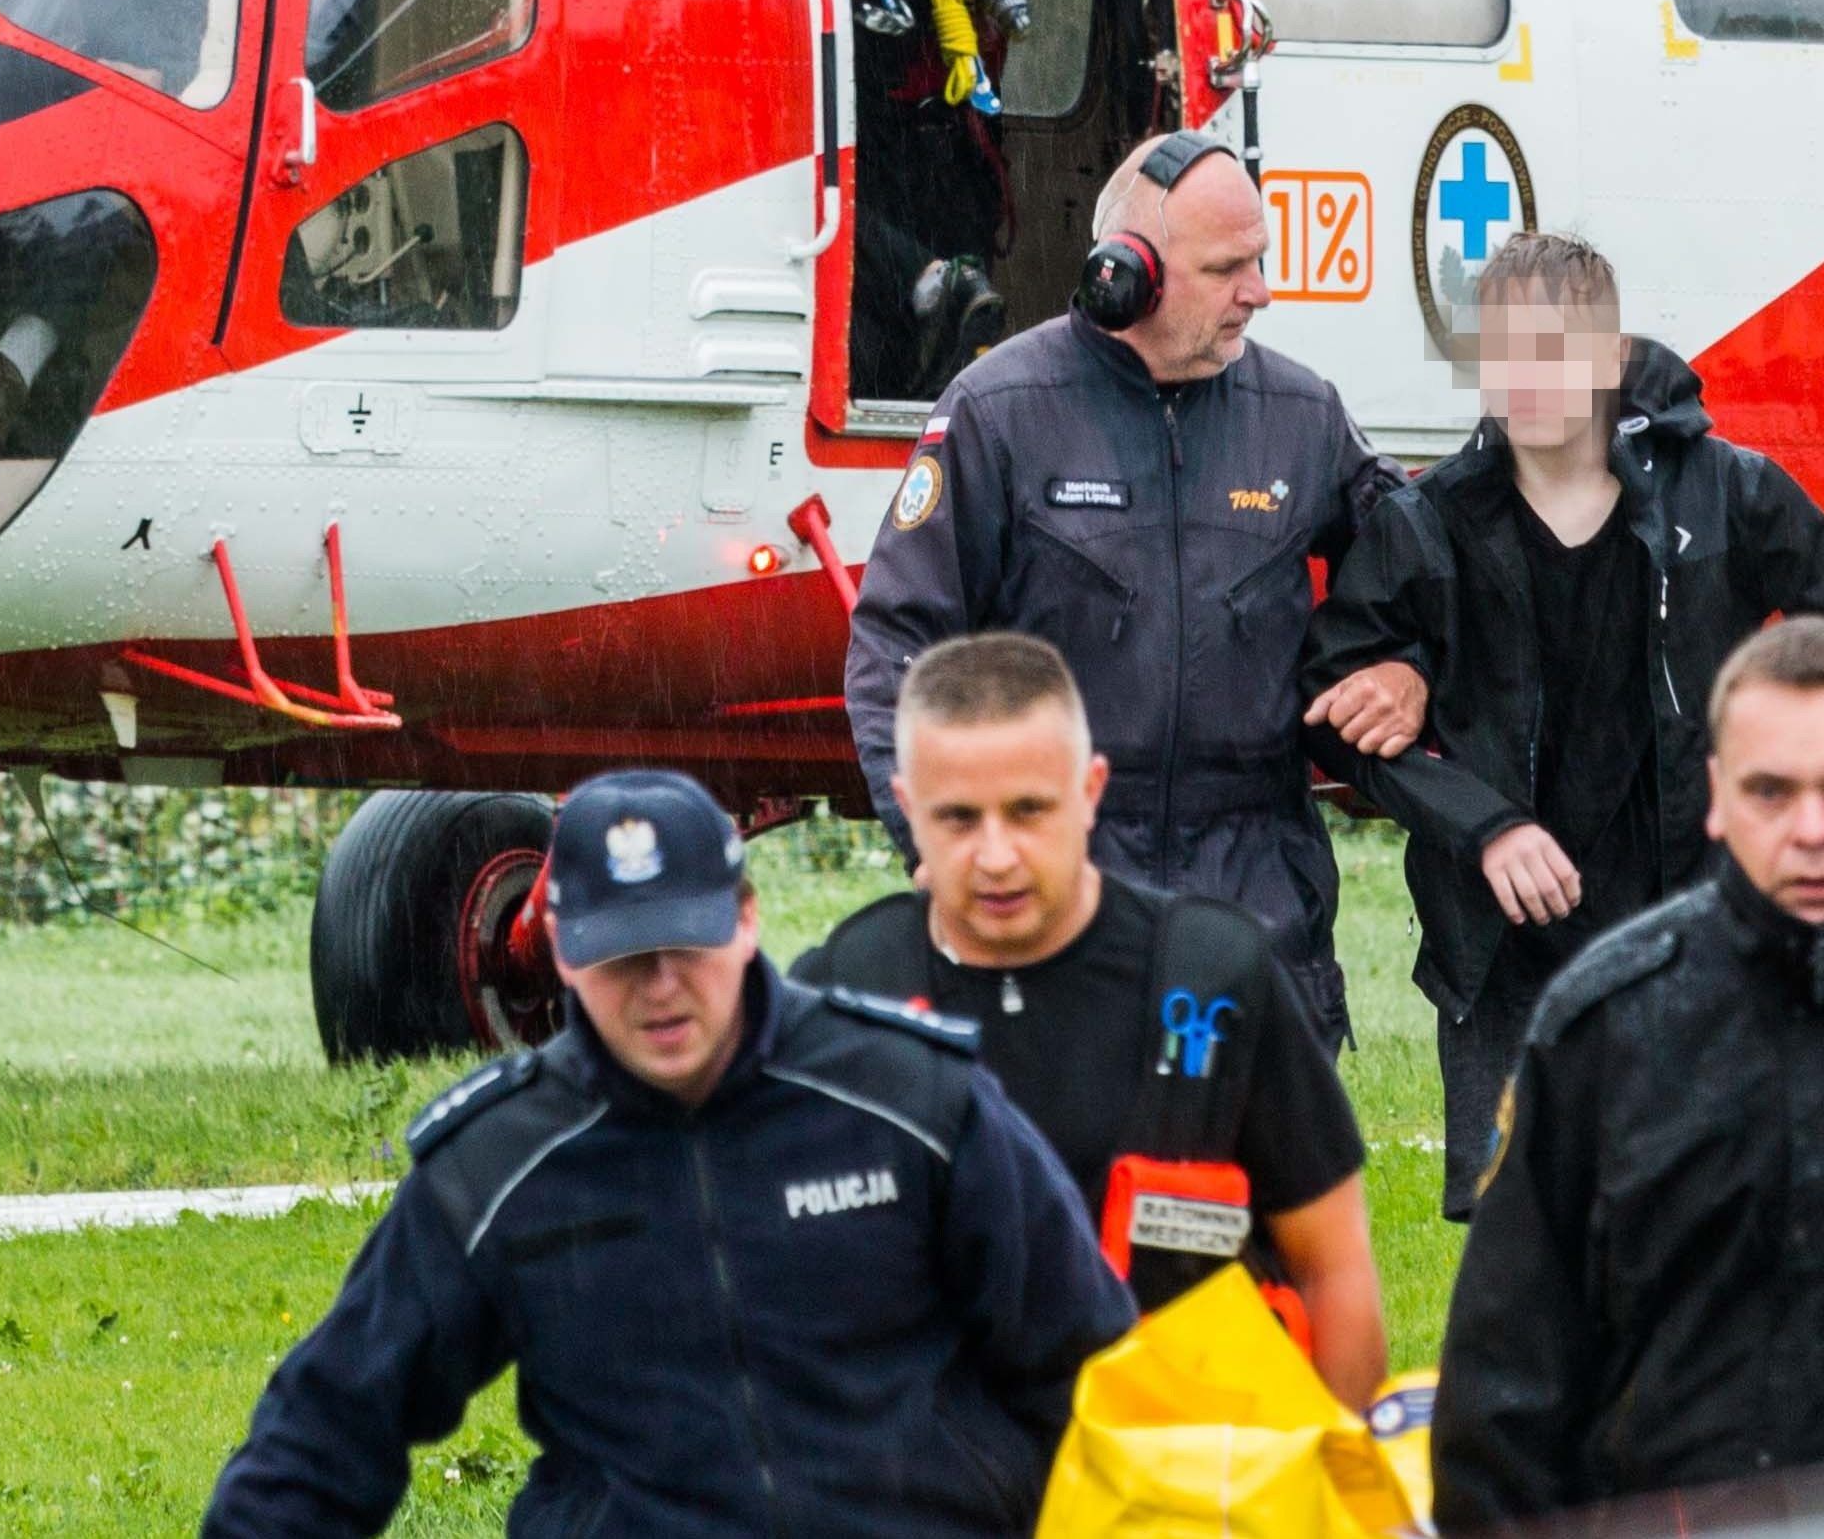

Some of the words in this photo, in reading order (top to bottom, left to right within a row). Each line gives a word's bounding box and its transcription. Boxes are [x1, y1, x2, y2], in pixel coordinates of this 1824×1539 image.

[1269, 192, 1358, 283] 1%
[1229, 489, 1280, 512] TOPR
[784, 1169, 898, 1219] POLICJA
